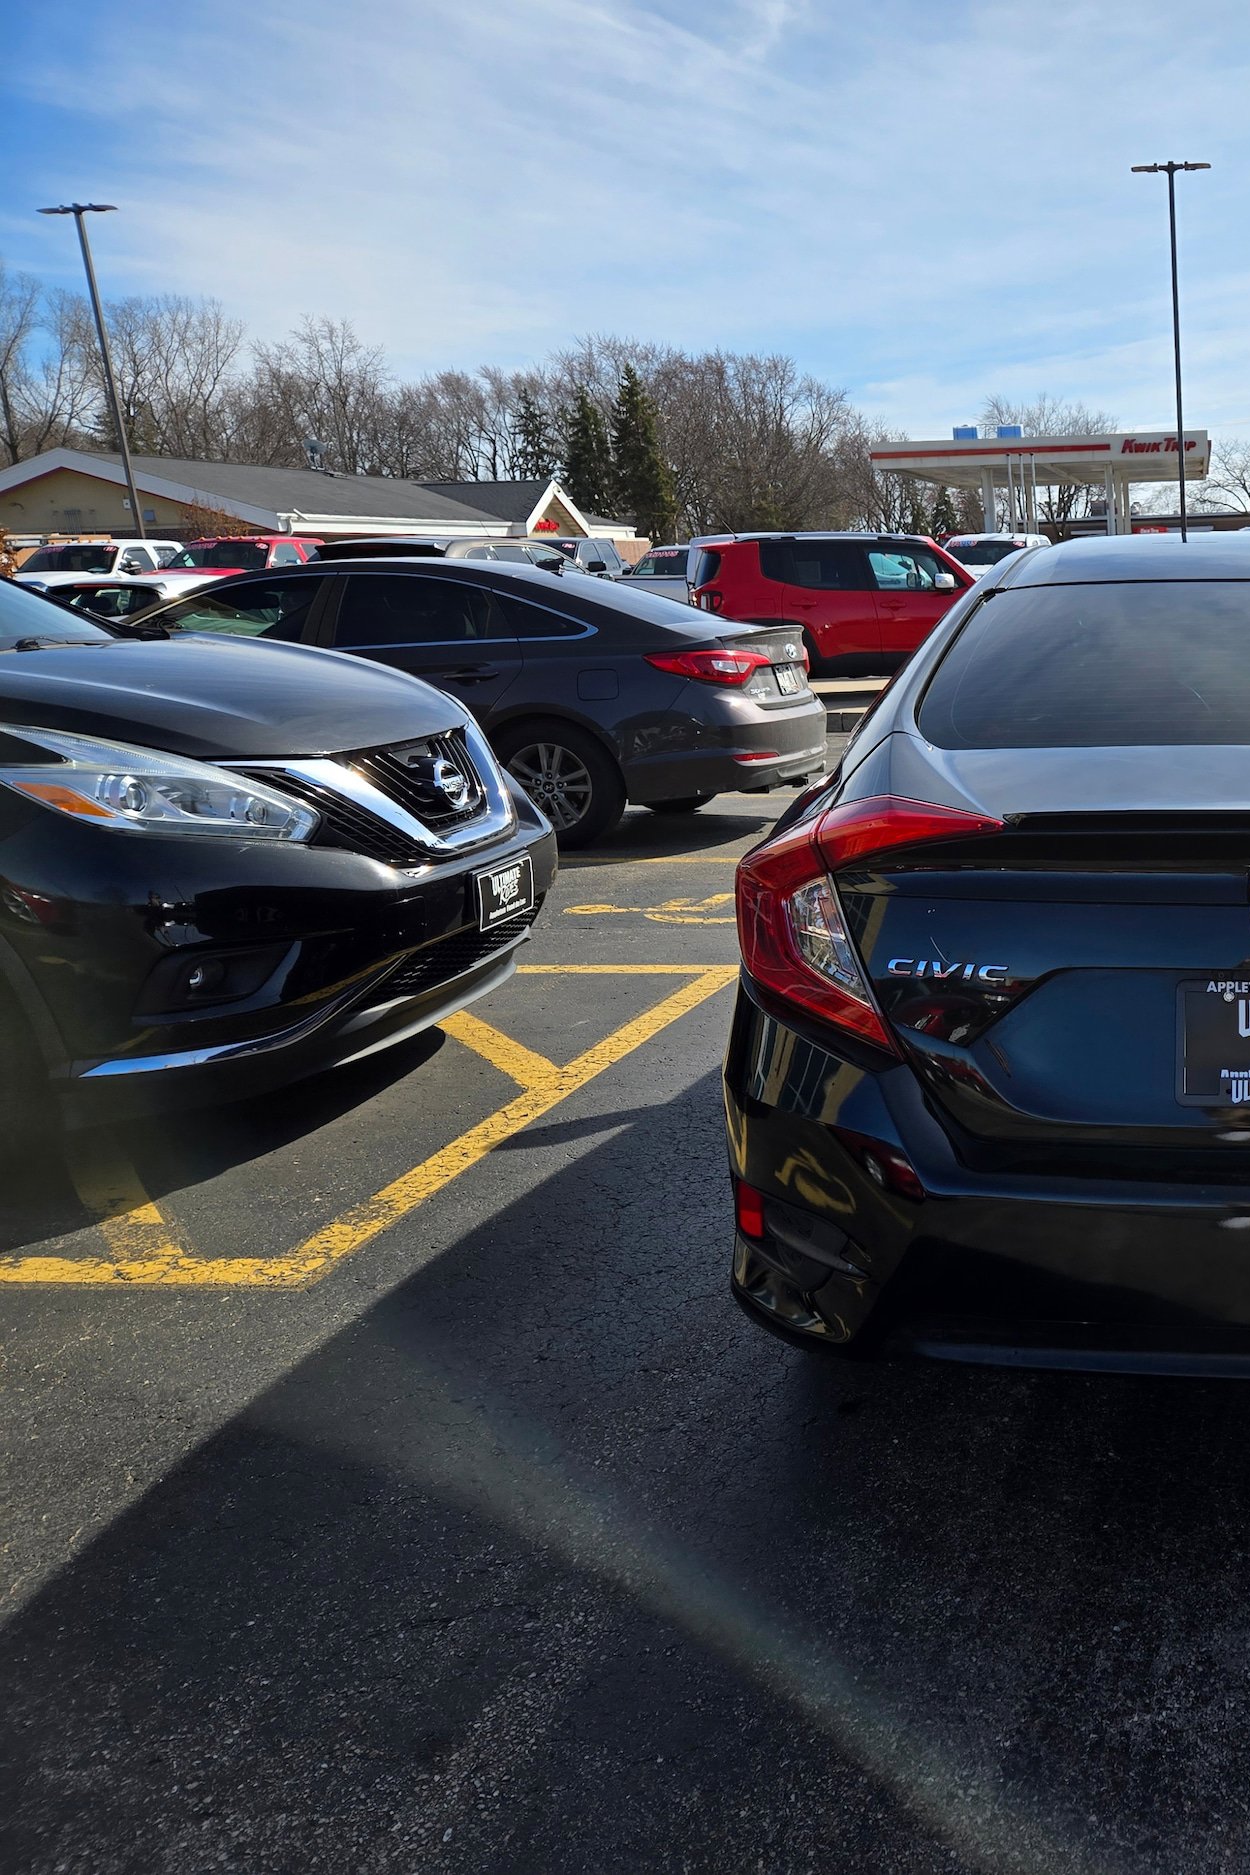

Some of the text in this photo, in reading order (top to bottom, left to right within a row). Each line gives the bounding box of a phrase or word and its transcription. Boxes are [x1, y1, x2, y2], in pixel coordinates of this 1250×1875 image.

[1121, 438, 1163, 454] KWIK
[491, 866, 521, 896] ULTIMATE
[887, 957, 1009, 983] CIVIC
